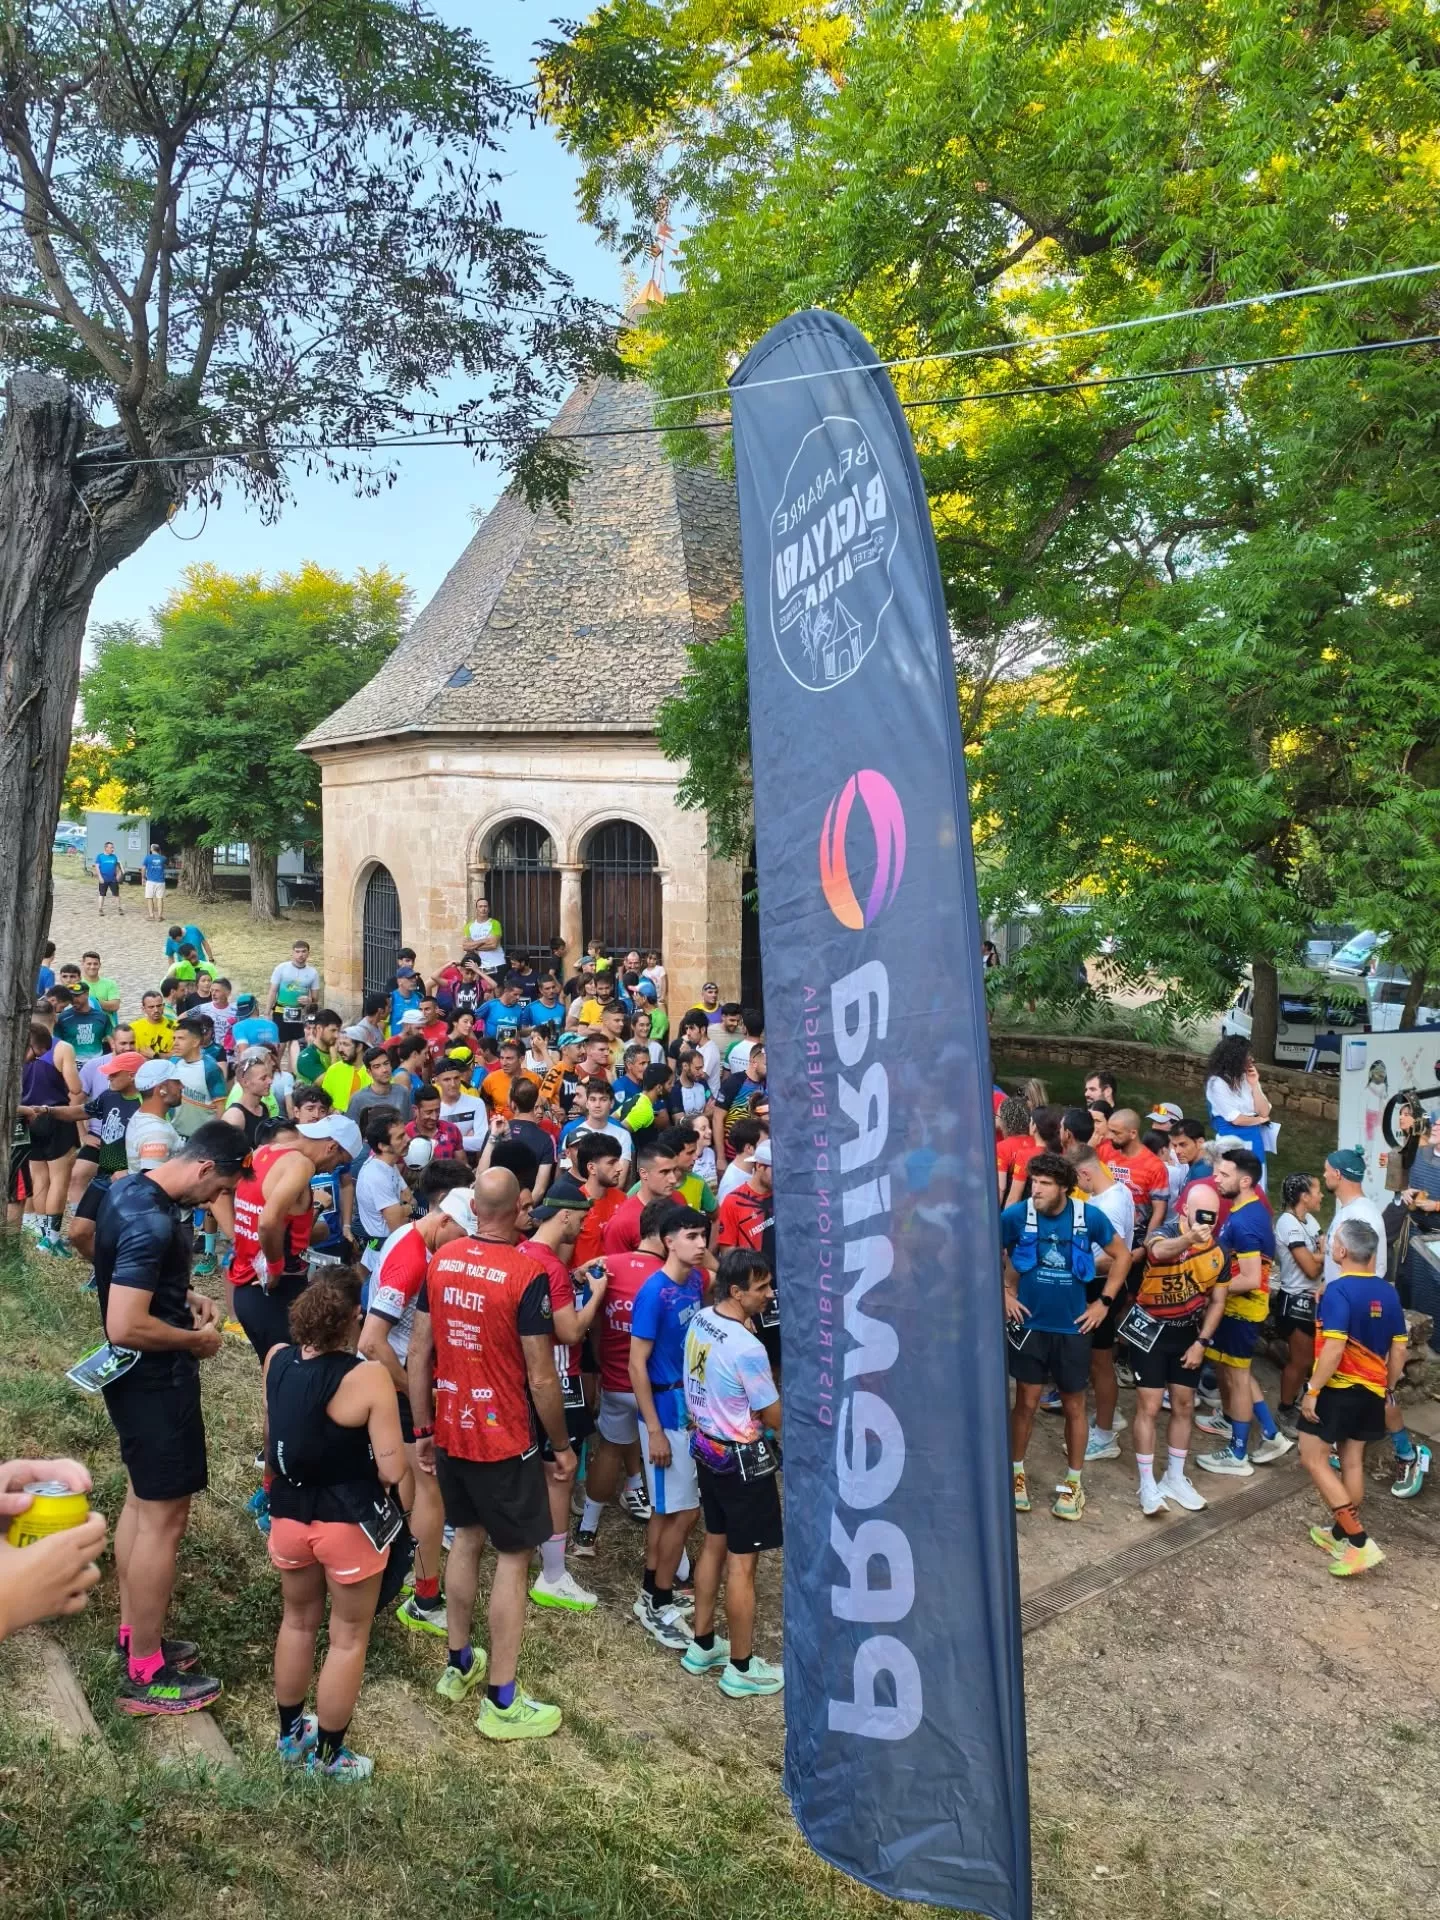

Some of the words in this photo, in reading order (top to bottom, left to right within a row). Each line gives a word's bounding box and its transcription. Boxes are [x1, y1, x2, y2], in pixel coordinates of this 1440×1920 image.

[437, 1258, 466, 1273] DRAGON
[465, 1262, 487, 1279] RACE
[486, 1268, 508, 1284] OCR
[443, 1286, 486, 1313] ATHLETE
[1154, 1285, 1201, 1305] FINISHER
[1296, 1298, 1310, 1309] 46
[692, 1314, 728, 1344] FINISHER
[1134, 1317, 1149, 1331] 67
[758, 1441, 766, 1455] 8
